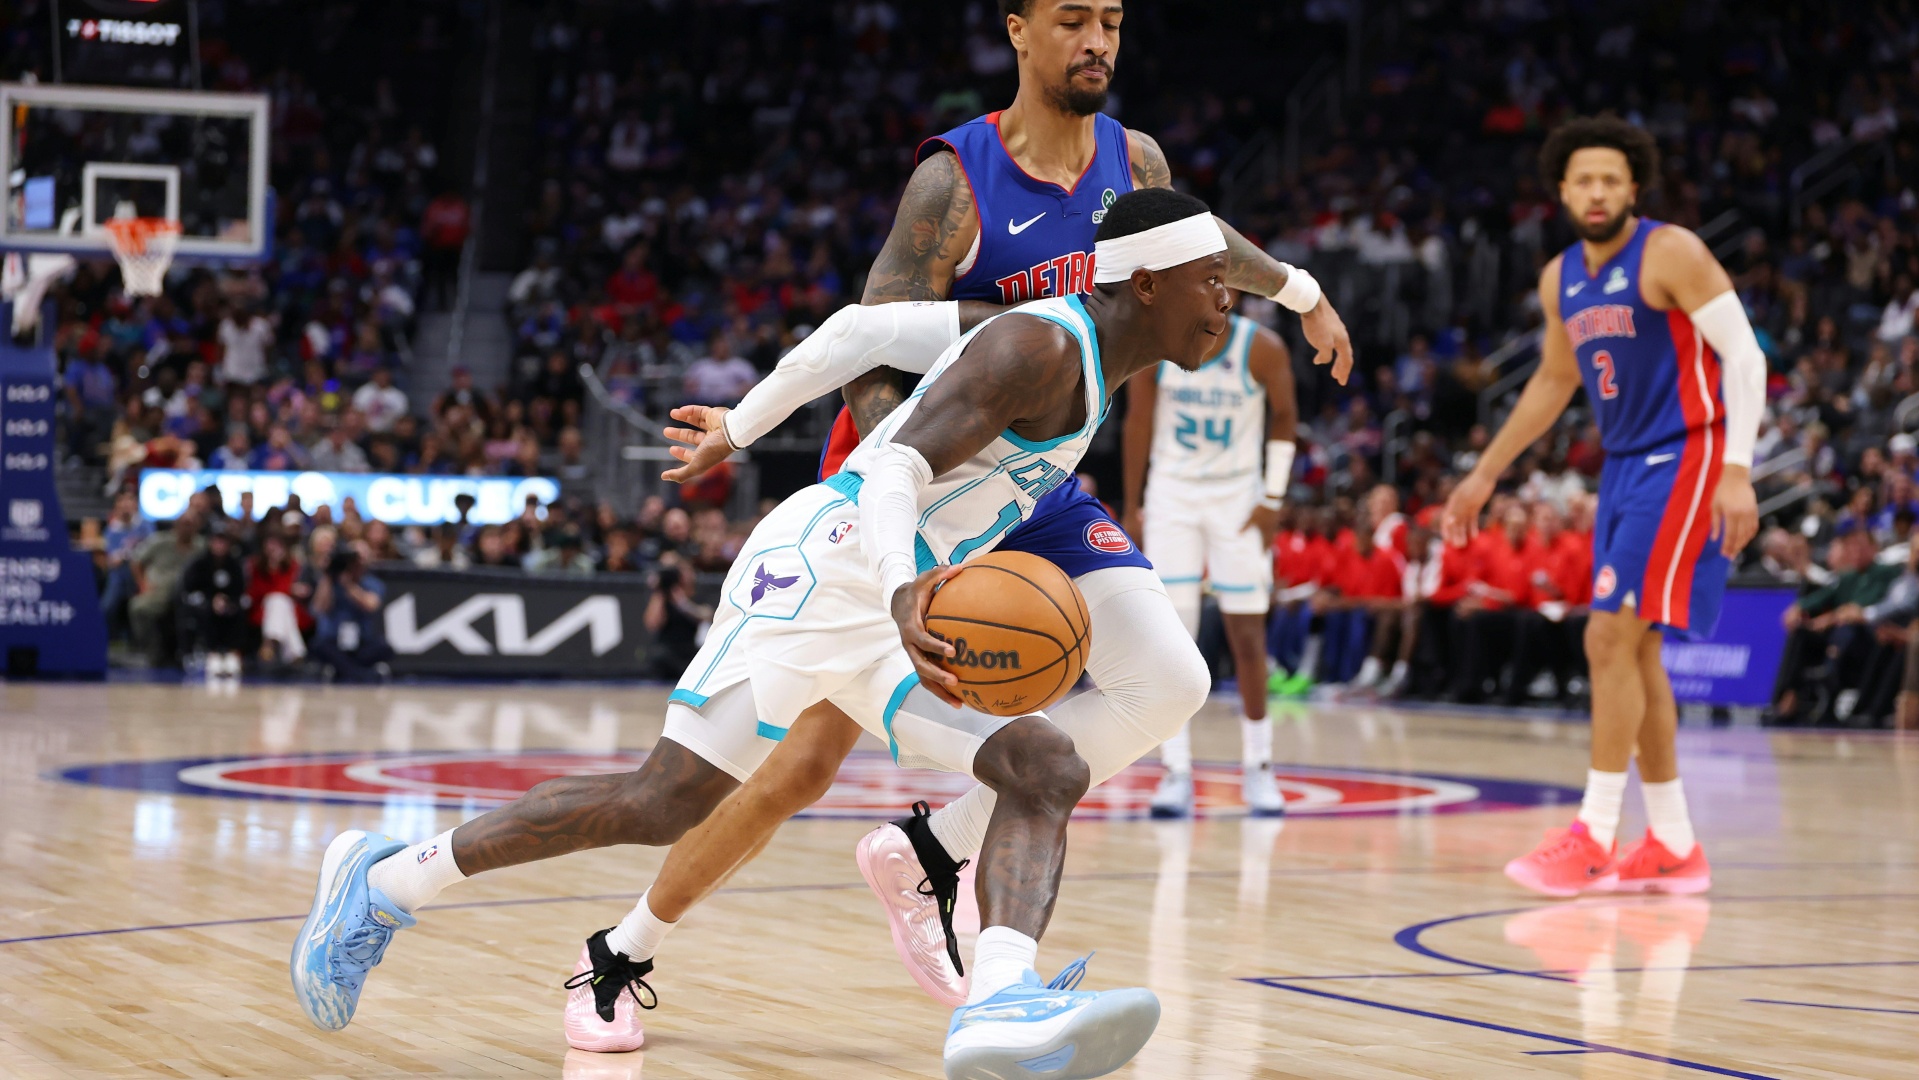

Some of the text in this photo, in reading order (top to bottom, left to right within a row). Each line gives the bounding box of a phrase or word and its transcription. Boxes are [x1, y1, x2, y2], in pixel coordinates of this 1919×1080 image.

[98, 19, 181, 46] TISSOT
[996, 251, 1096, 306] DETRO
[1565, 304, 1637, 351] DETROIT
[1592, 350, 1619, 400] 2
[1175, 411, 1233, 451] 24
[1095, 536, 1127, 546] PISTONS
[0, 557, 60, 582] ENRY
[0, 600, 74, 626] EALTH
